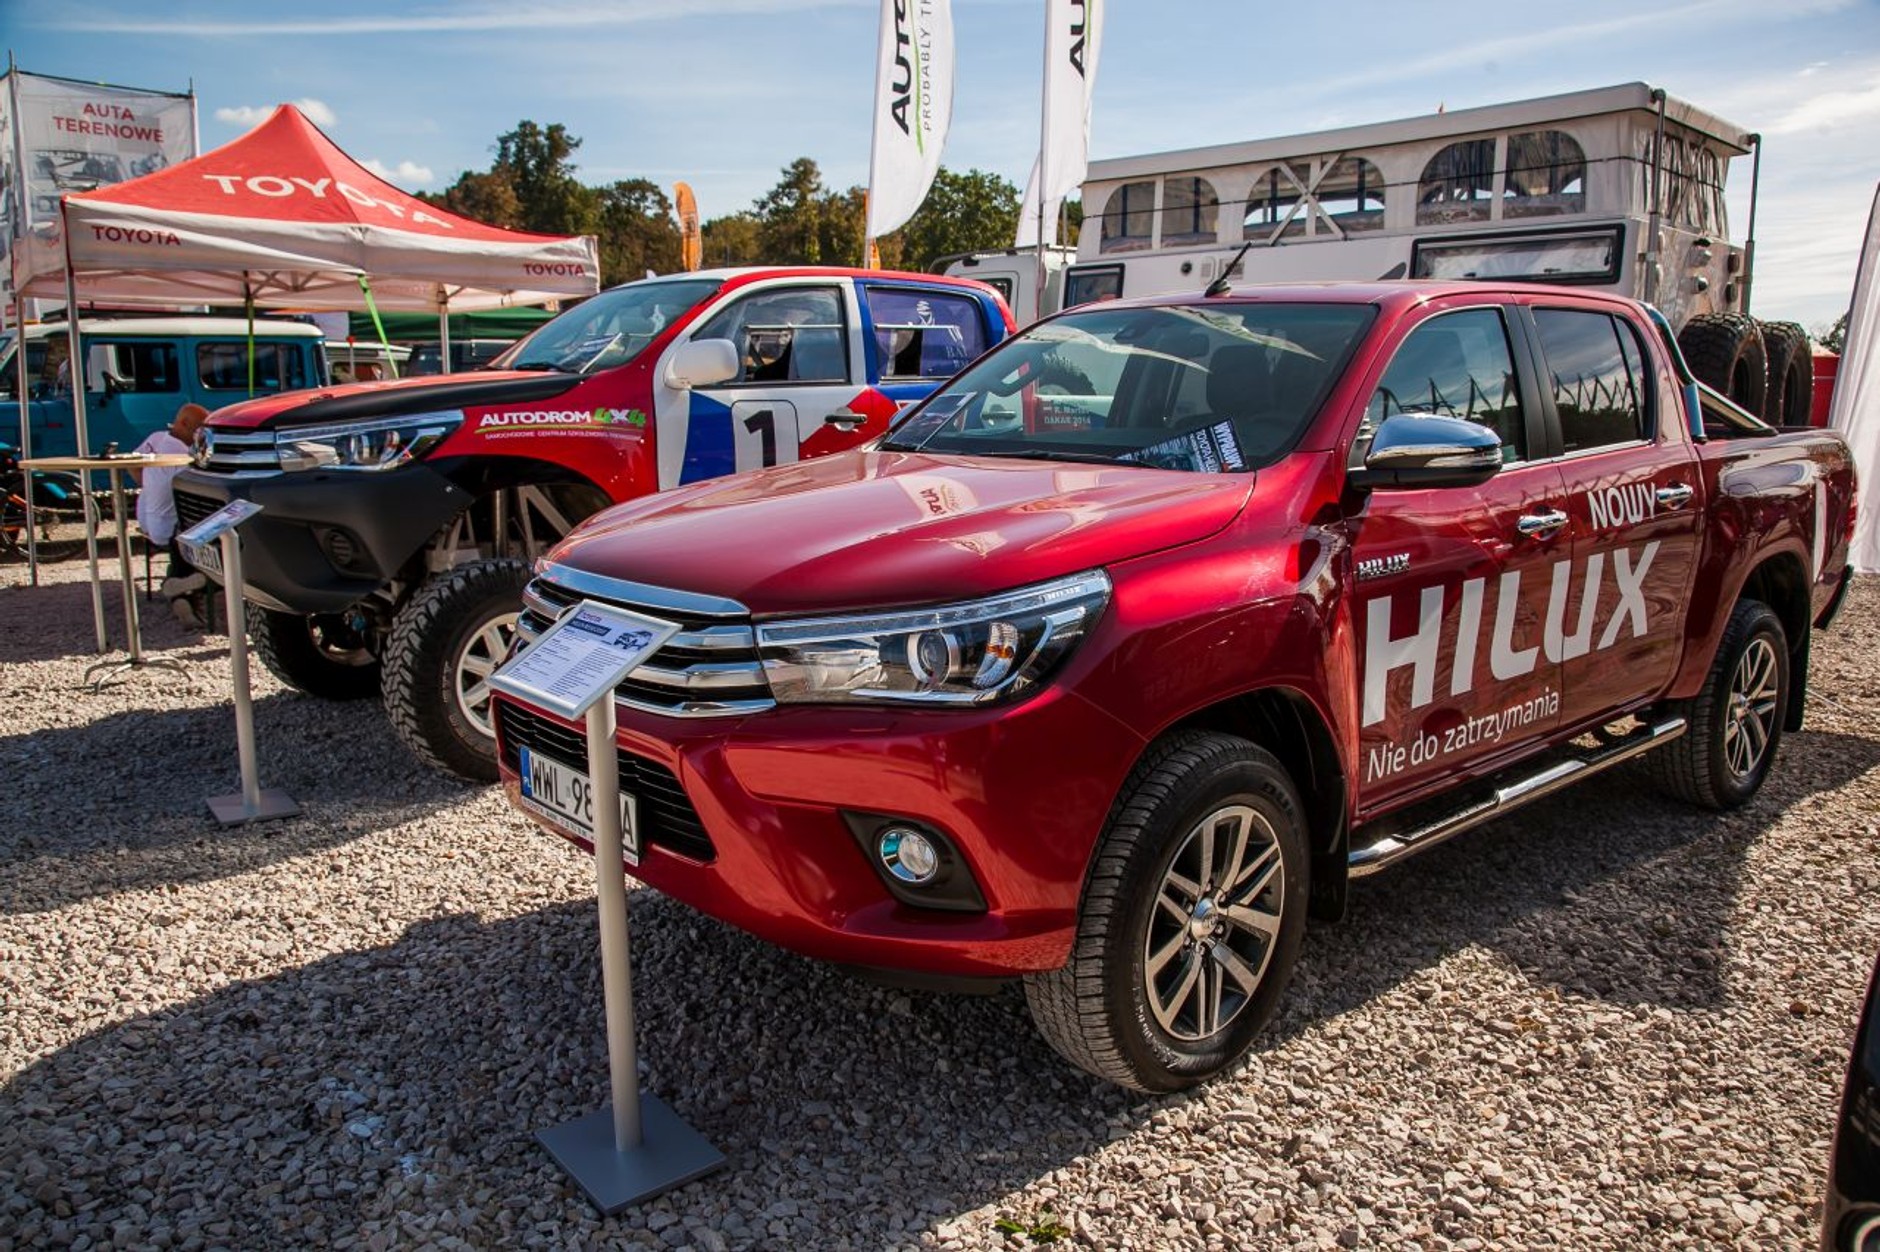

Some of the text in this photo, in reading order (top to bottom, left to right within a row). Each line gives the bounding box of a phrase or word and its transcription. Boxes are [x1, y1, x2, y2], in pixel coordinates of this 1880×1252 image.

[920, 28, 932, 131] PROBABLY
[53, 116, 164, 143] TERENOWE
[83, 102, 135, 121] AUTA
[202, 174, 454, 229] TOYOTA
[91, 225, 182, 246] TOYOTA
[523, 263, 585, 276] TOYOTA
[480, 411, 591, 426] AUTODROM
[743, 409, 777, 468] 1
[1587, 482, 1658, 531] NOWY
[1358, 553, 1410, 578] HILUX
[1362, 541, 1662, 728] HILUX
[1367, 687, 1559, 783] Nie do zatrzymania
[530, 755, 566, 810] WWL
